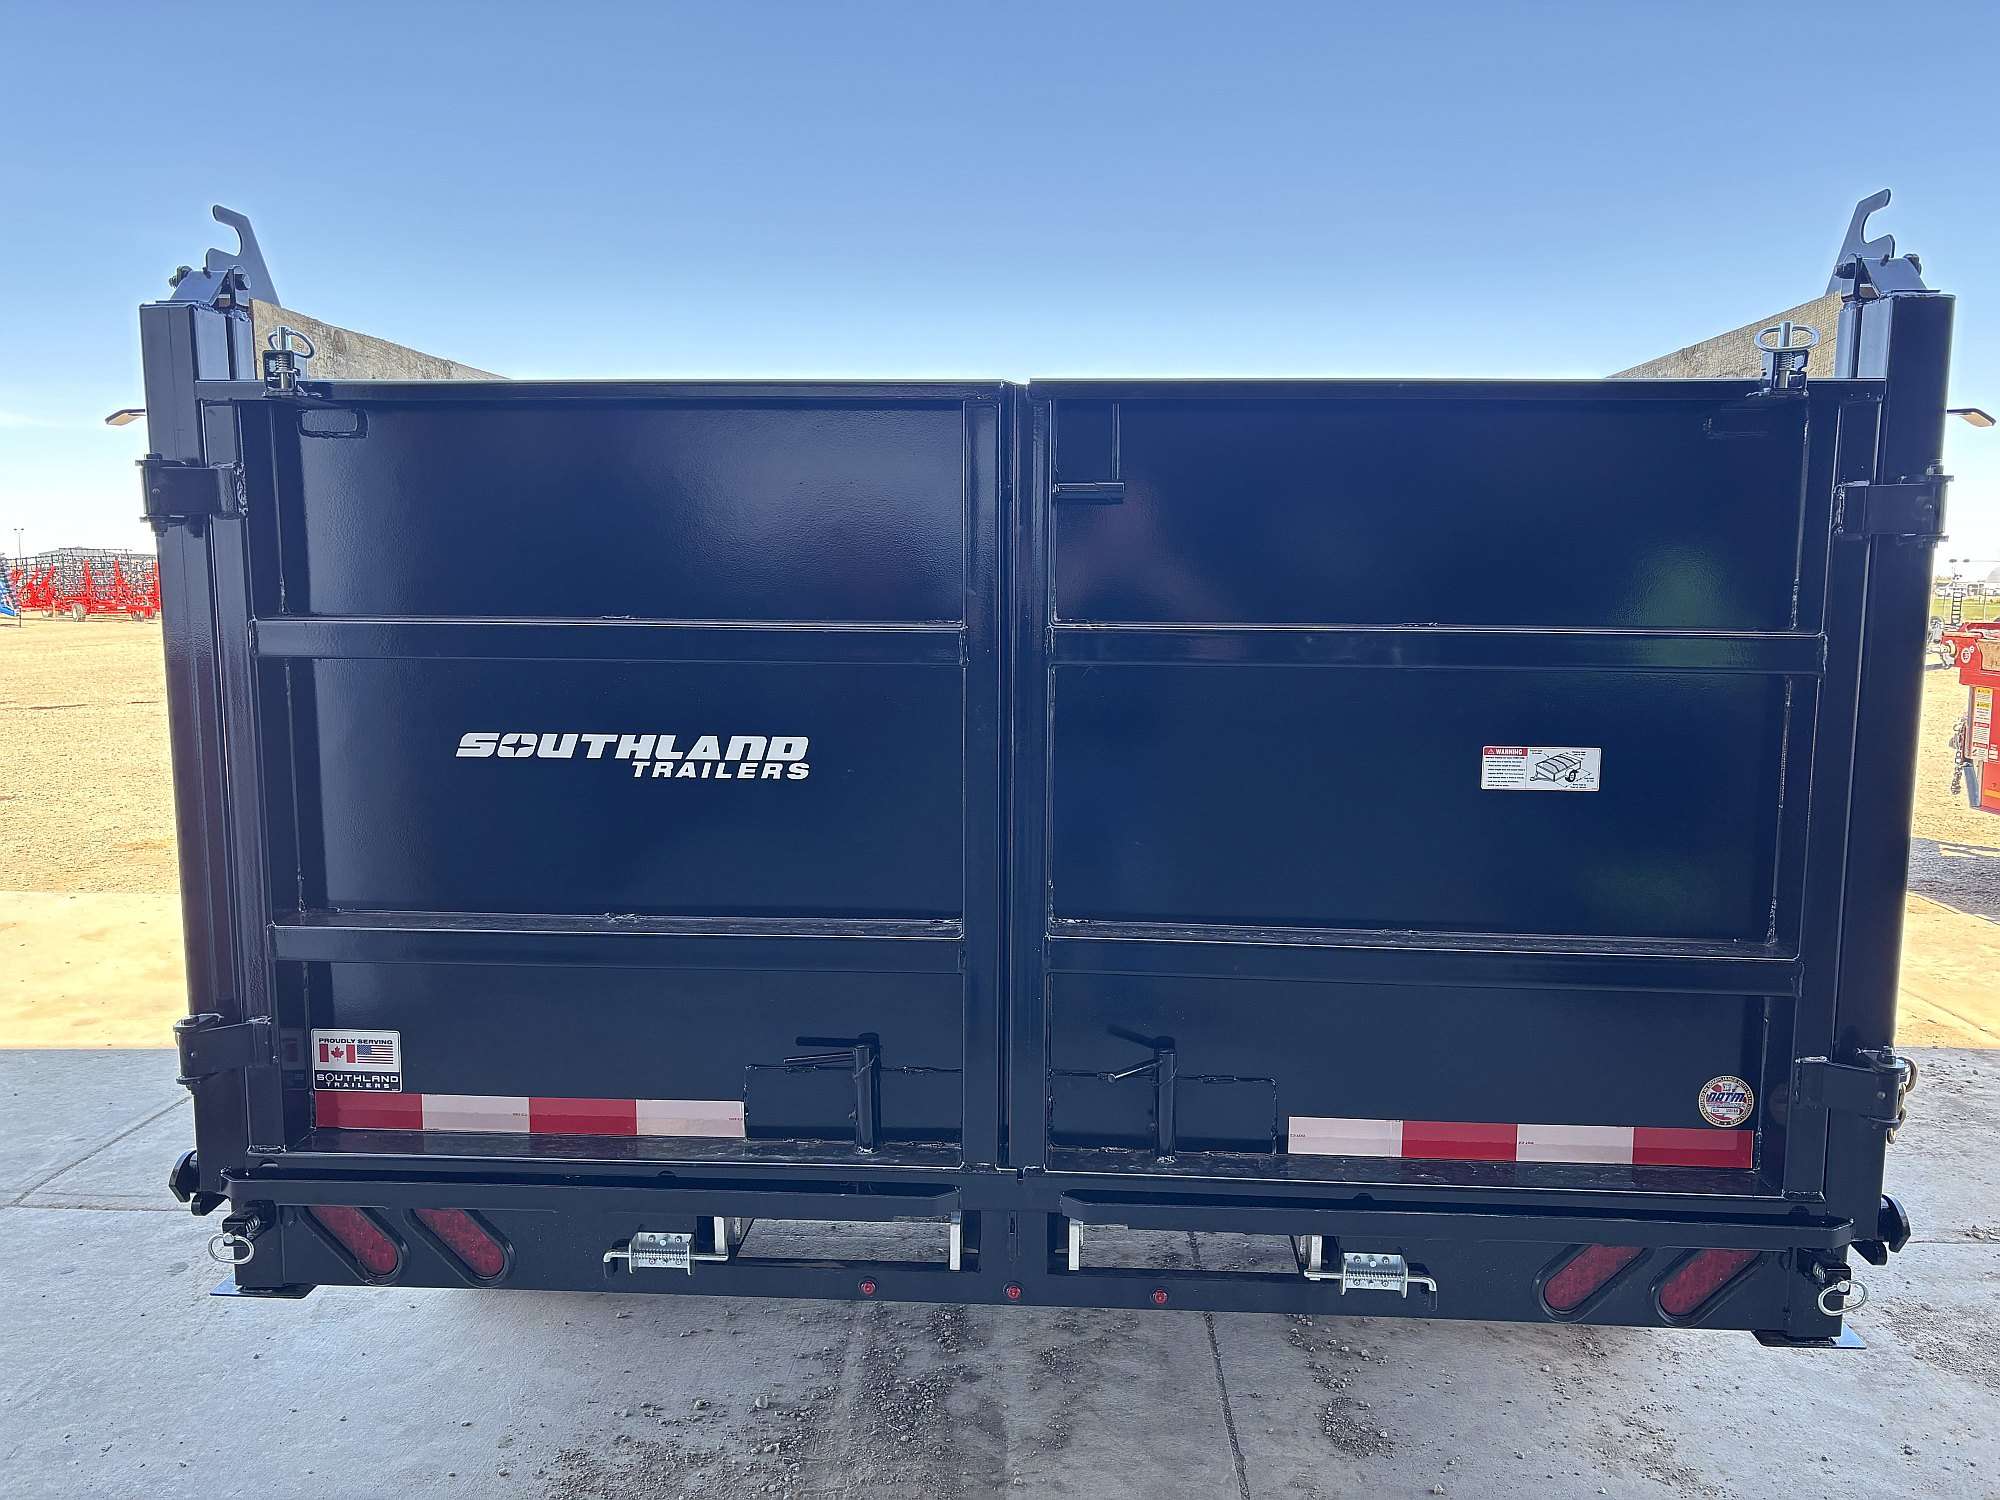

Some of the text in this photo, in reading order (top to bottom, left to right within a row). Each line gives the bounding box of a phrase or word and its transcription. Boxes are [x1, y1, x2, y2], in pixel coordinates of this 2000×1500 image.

[455, 732, 810, 761] SOUTHLAND
[631, 761, 811, 780] TRAILERS
[316, 1072, 399, 1083] SOUTHLAND
